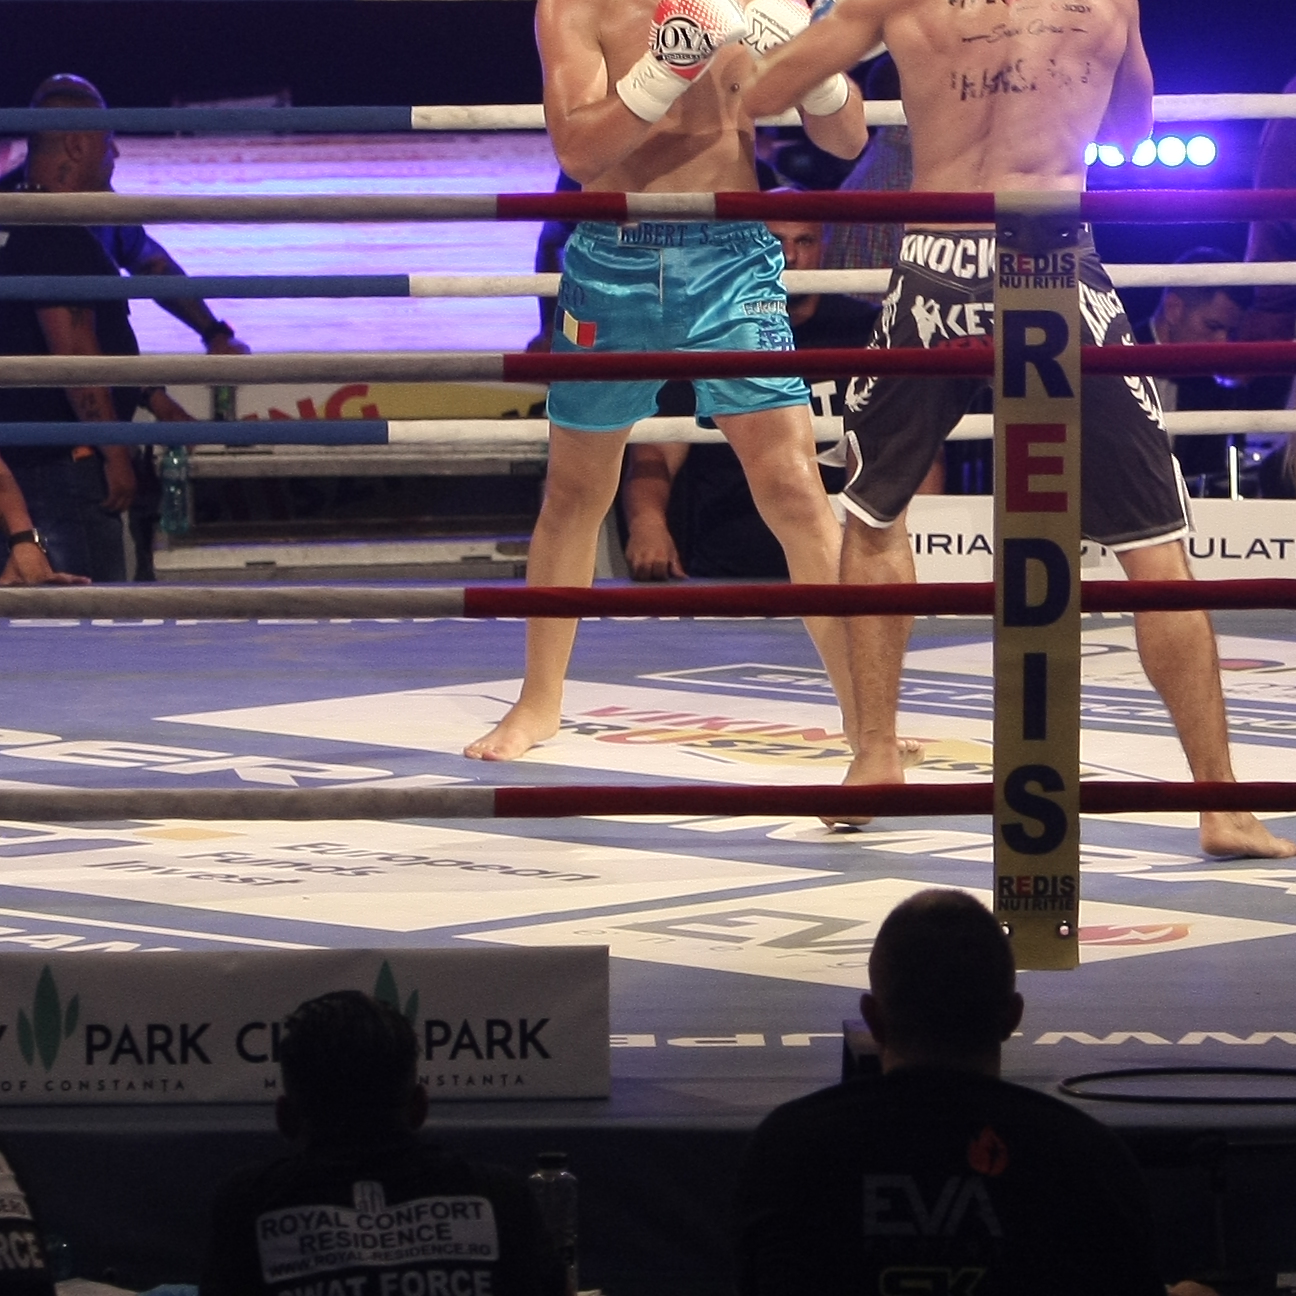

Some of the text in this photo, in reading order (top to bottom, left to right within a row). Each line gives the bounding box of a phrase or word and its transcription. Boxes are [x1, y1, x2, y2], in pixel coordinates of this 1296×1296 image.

[999, 252, 1076, 273] REDIS
[999, 275, 1076, 290] NUTRITIE
[83, 859, 308, 887] Invest
[177, 851, 388, 878] Funds
[273, 841, 602, 883] European
[998, 875, 1075, 896] REDIS
[571, 929, 871, 973] energ
[85, 1022, 212, 1066] PARK
[424, 1018, 552, 1061] PARK
[0, 1080, 28, 1092] OF
[862, 1172, 1004, 1238] EVA
[259, 1201, 486, 1241] ROYAL CONFORT
[298, 1223, 454, 1255] RESIDENCE
[379, 1269, 493, 1296] FORCE
